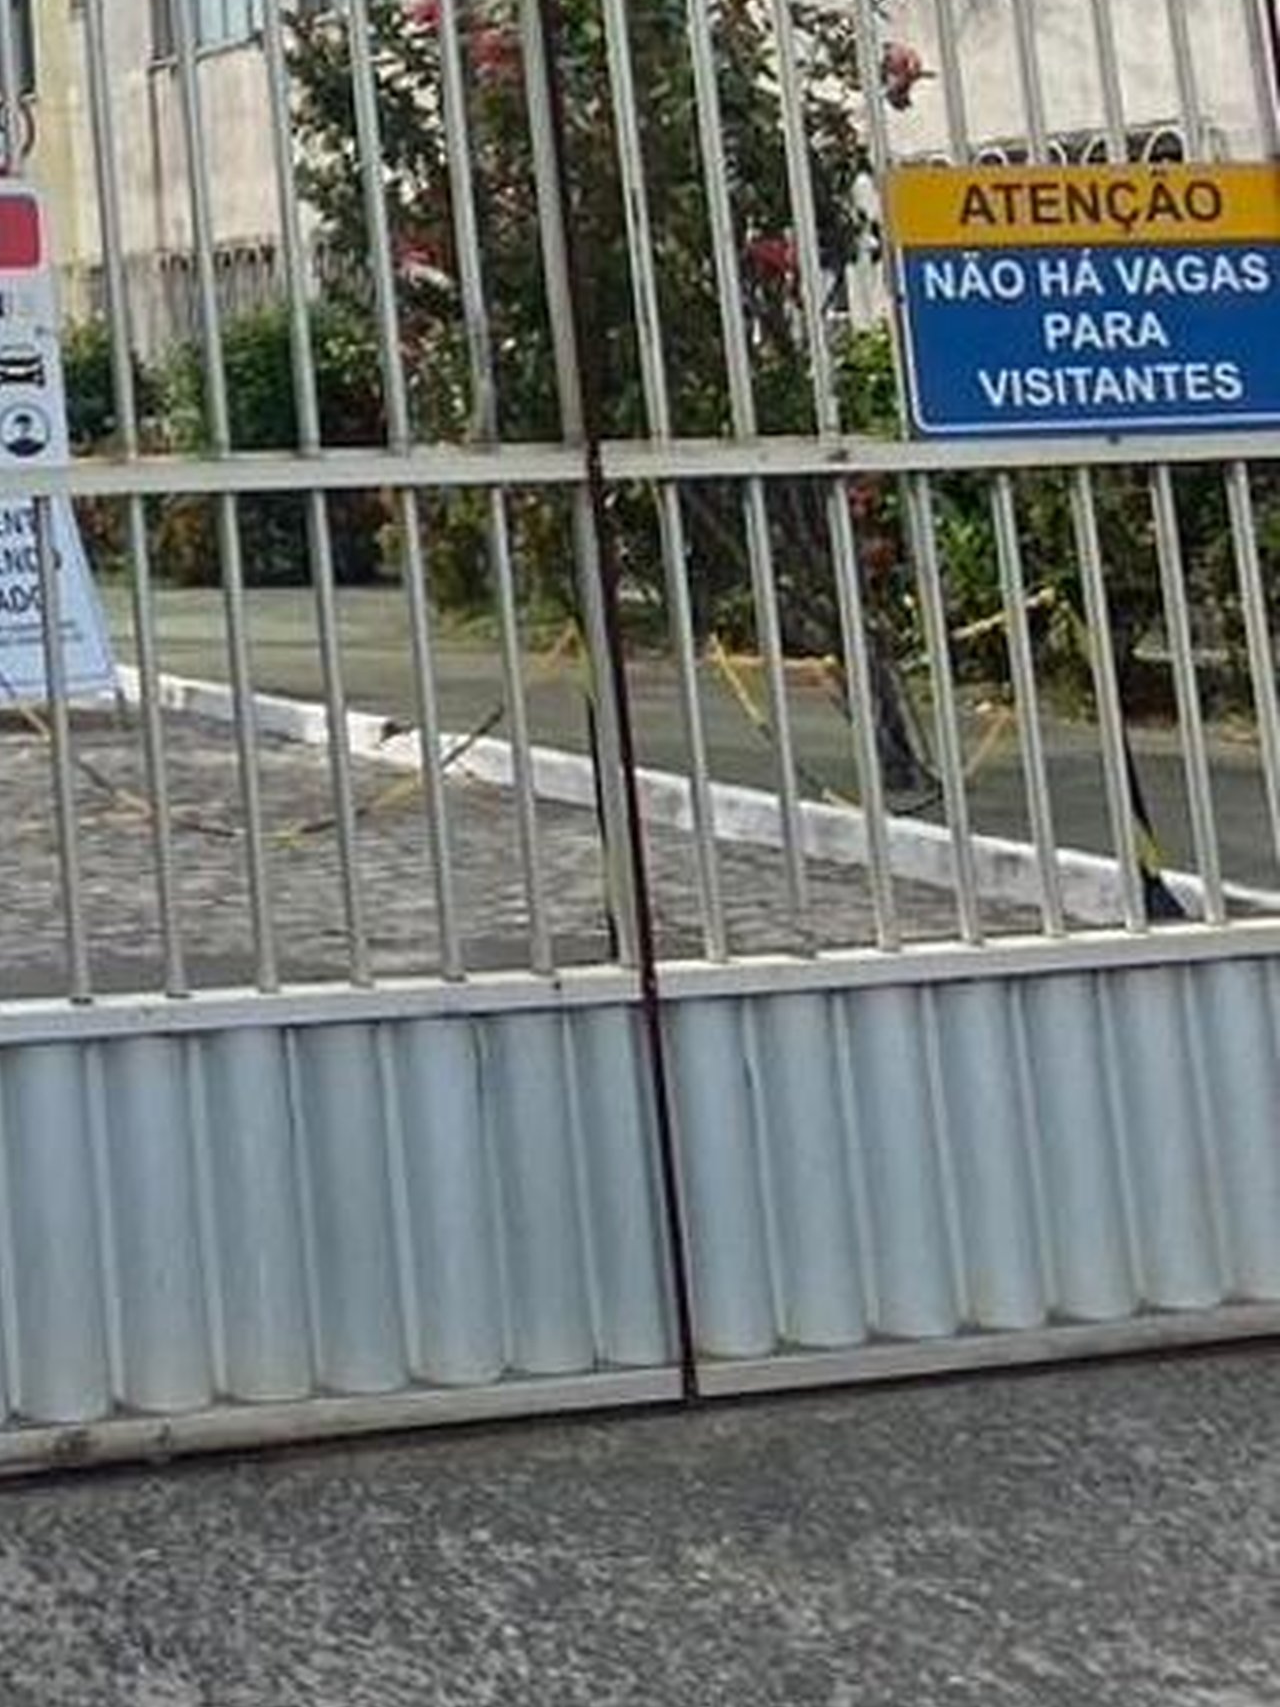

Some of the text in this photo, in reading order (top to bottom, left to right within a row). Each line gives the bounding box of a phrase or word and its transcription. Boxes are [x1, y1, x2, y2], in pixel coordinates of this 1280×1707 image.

[959, 170, 1223, 233] ATENÇÃO
[924, 247, 1272, 301] NÃO HÁ VAGAS
[1042, 311, 1170, 352] PARA
[978, 363, 1244, 407] VISITANTES
